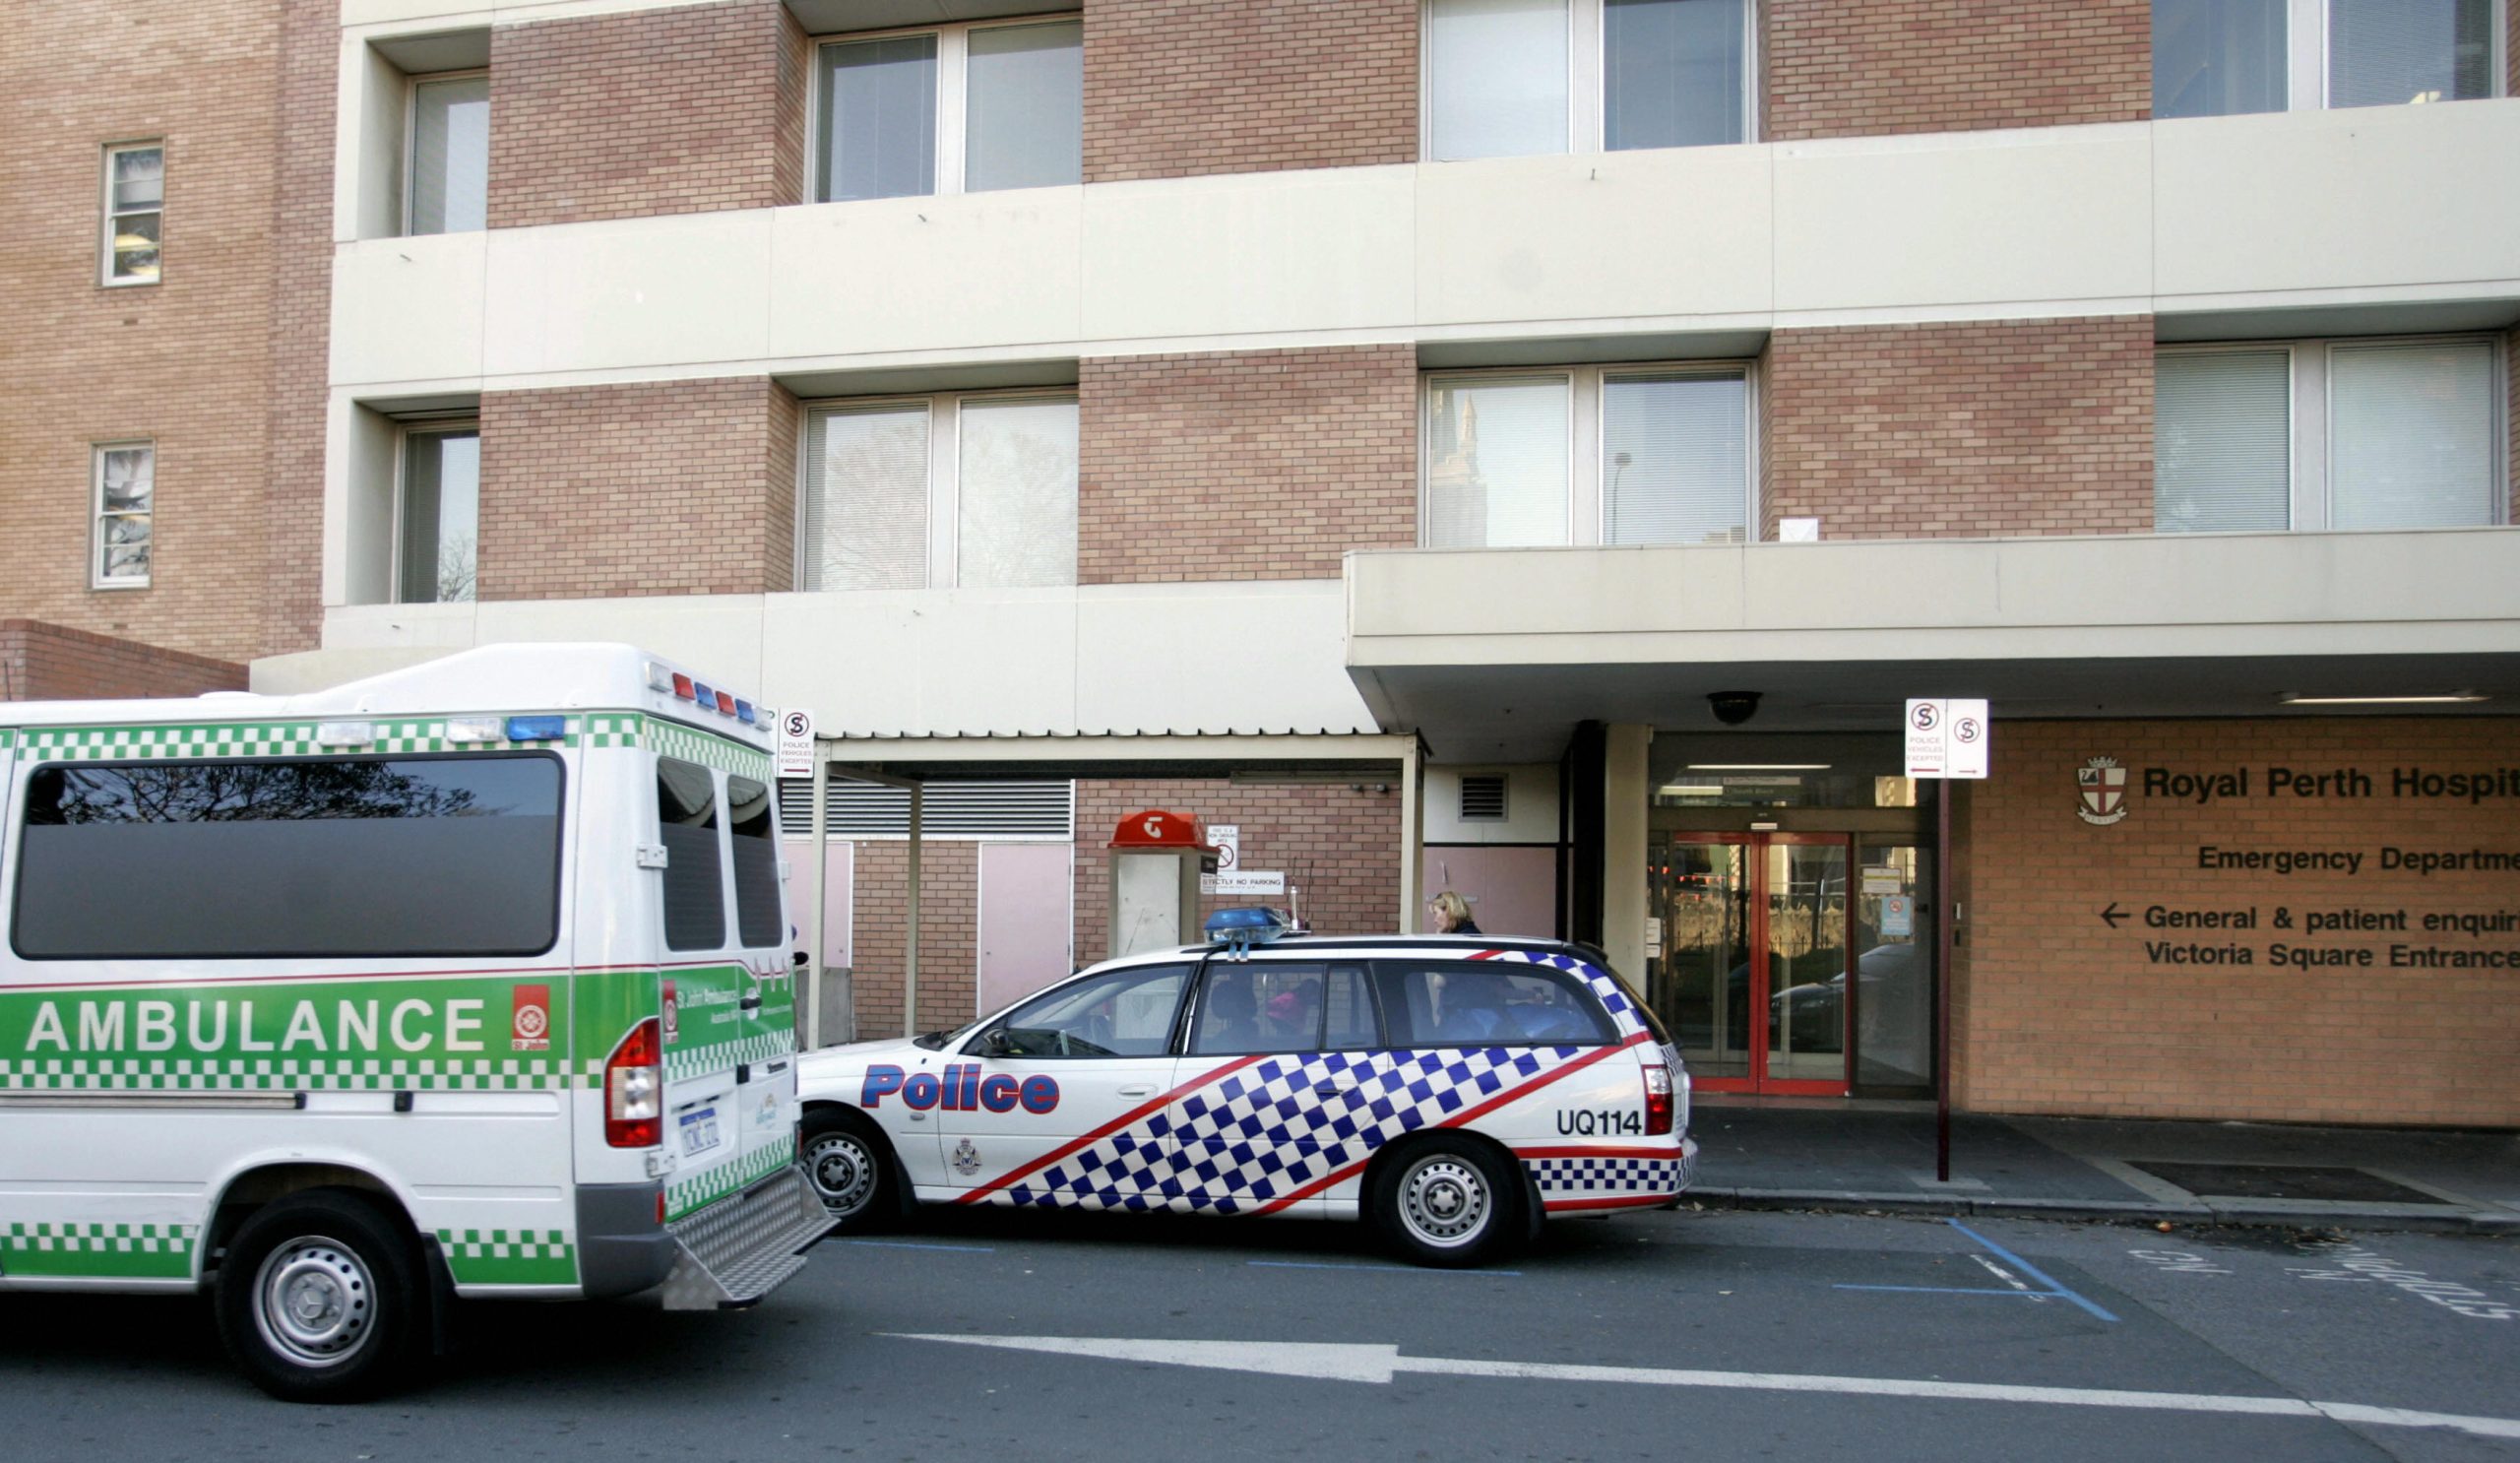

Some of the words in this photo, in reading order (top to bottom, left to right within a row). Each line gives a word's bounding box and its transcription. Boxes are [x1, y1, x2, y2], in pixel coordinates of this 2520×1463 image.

[2143, 767, 2248, 804] Royal
[2267, 767, 2372, 797] Perth
[2198, 846, 2363, 875] Emergency
[2144, 905, 2257, 930] General
[2273, 907, 2294, 929] &
[2306, 909, 2407, 935] patient
[2145, 941, 2253, 966] Victoria
[2269, 943, 2373, 971] Square
[2390, 944, 2520, 969] Entrance
[25, 998, 485, 1052] AMBULANCE
[860, 1063, 1060, 1114] Police
[1557, 1109, 1642, 1135] UQ114
